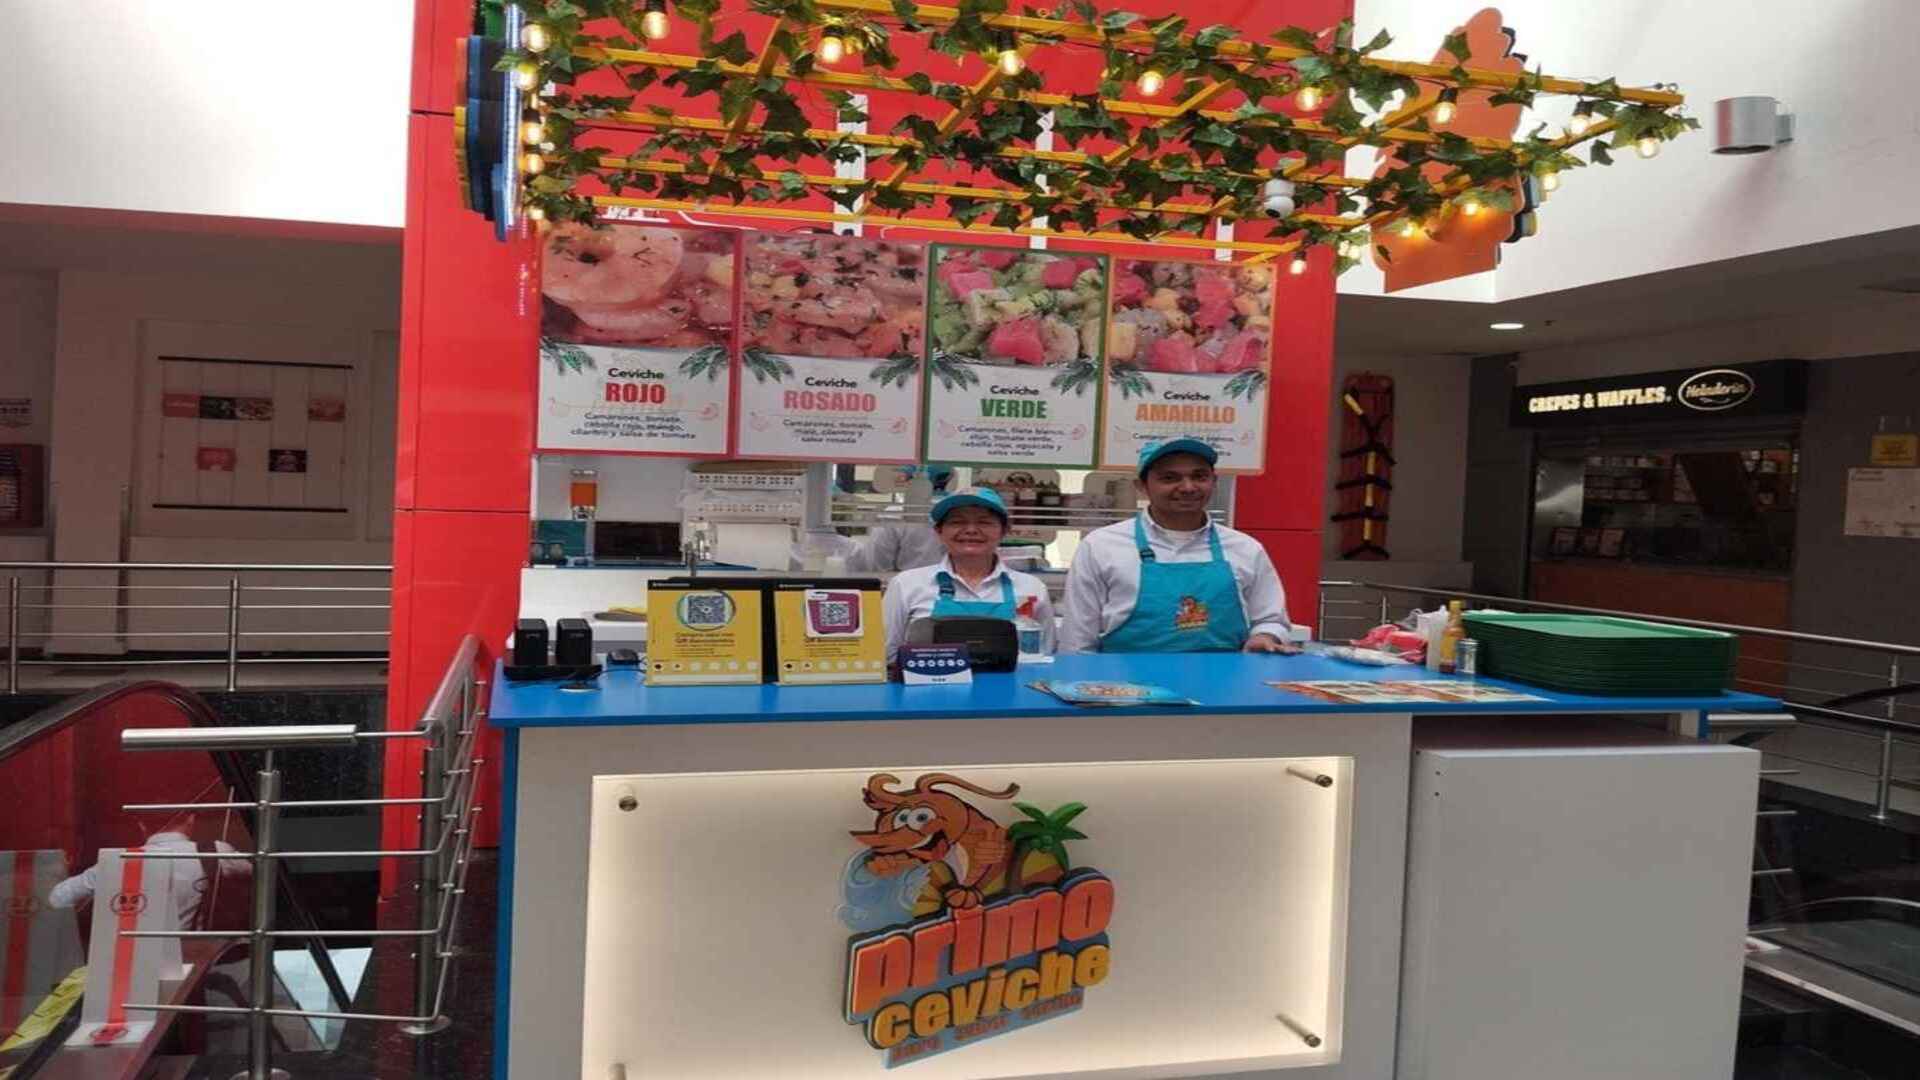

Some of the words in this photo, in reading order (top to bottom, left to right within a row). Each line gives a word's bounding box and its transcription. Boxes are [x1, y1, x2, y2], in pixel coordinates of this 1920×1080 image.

[607, 368, 665, 379] Ceviche
[804, 376, 858, 388] Ceviche
[605, 382, 666, 404] ROJO
[990, 385, 1040, 396] Ceviche
[1163, 390, 1211, 401] Ceviche
[783, 390, 877, 412] ROSADO
[980, 398, 1048, 419] VERDE
[1528, 393, 1581, 413] CREPES
[1583, 393, 1595, 409] &
[1135, 403, 1236, 424] AMARILLO
[661, 432, 697, 440] tomate
[852, 878, 1115, 1016] primo
[872, 944, 1110, 1049] ceviche
